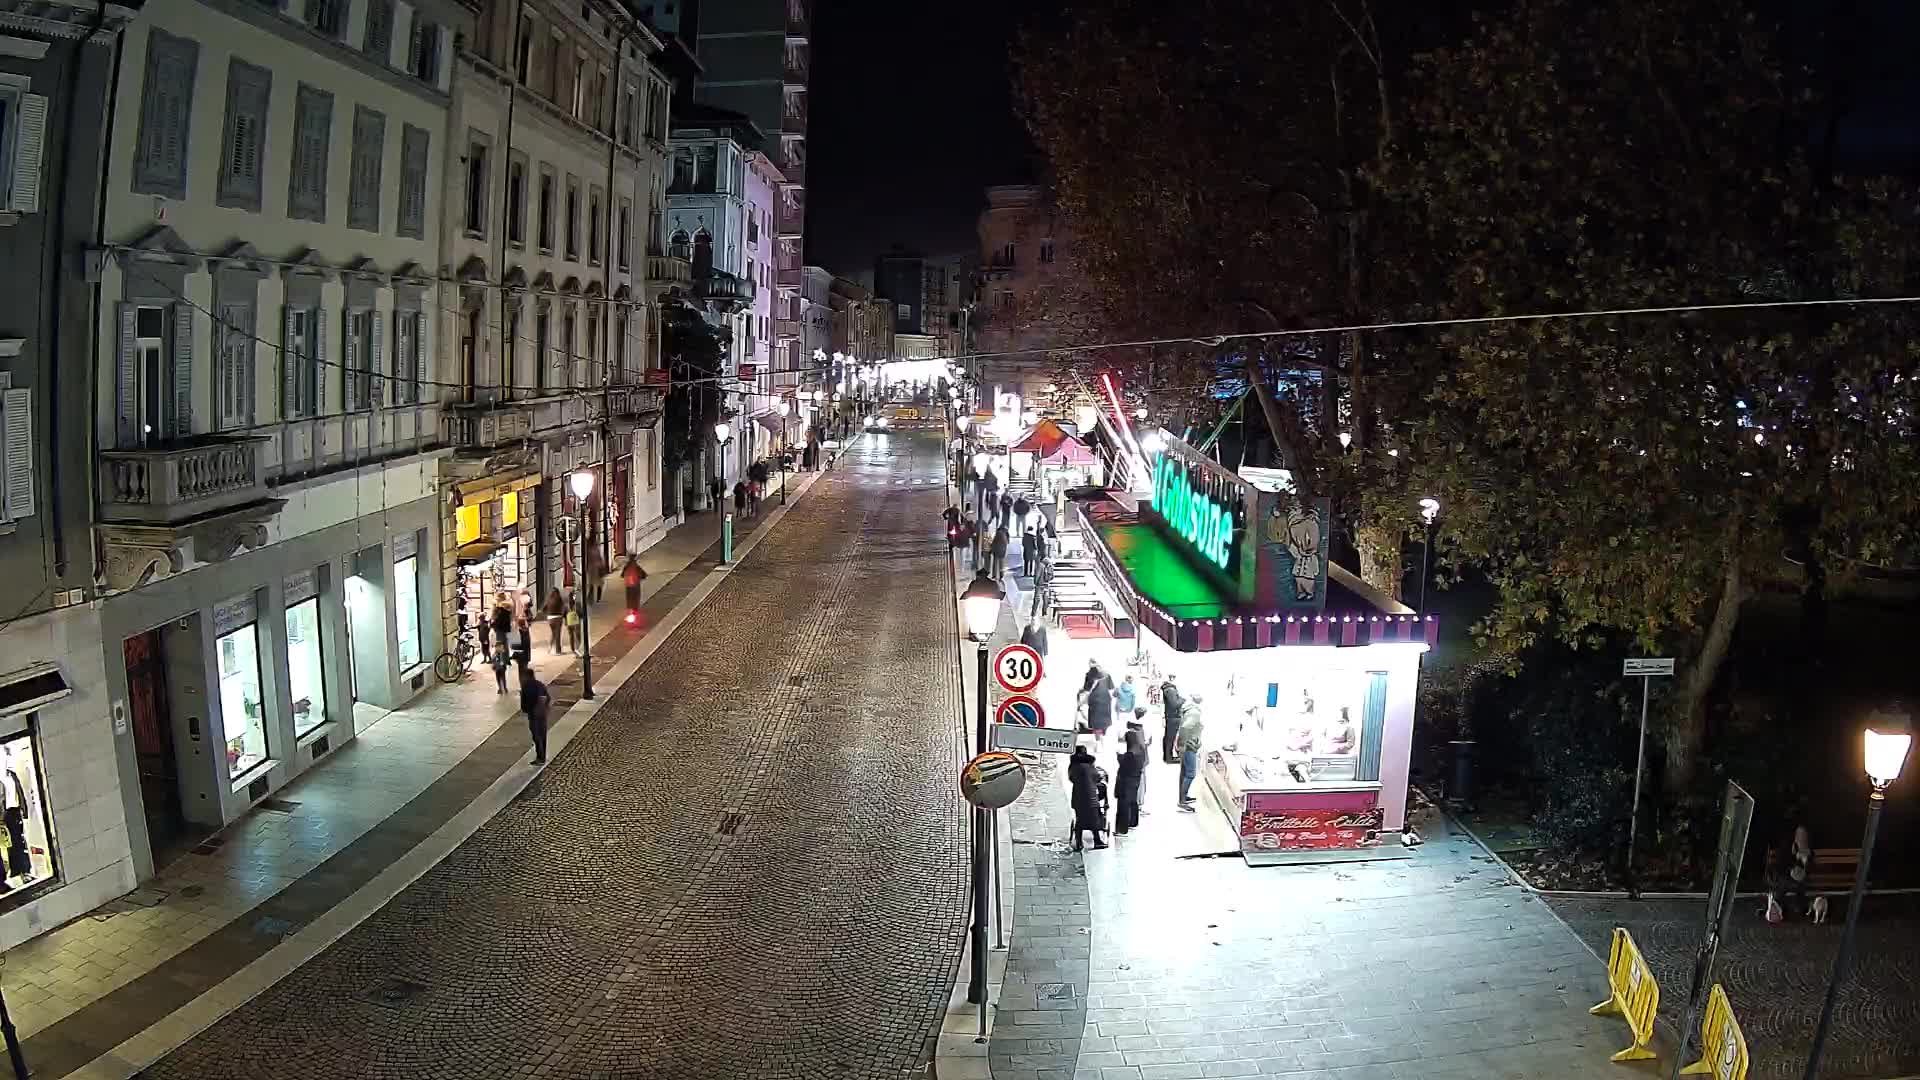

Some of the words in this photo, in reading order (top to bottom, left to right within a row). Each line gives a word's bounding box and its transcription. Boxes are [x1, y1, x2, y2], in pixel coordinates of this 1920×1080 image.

[1163, 459, 1233, 569] Golosone
[1006, 658, 1032, 680] 30
[1038, 738, 1070, 749] Dante
